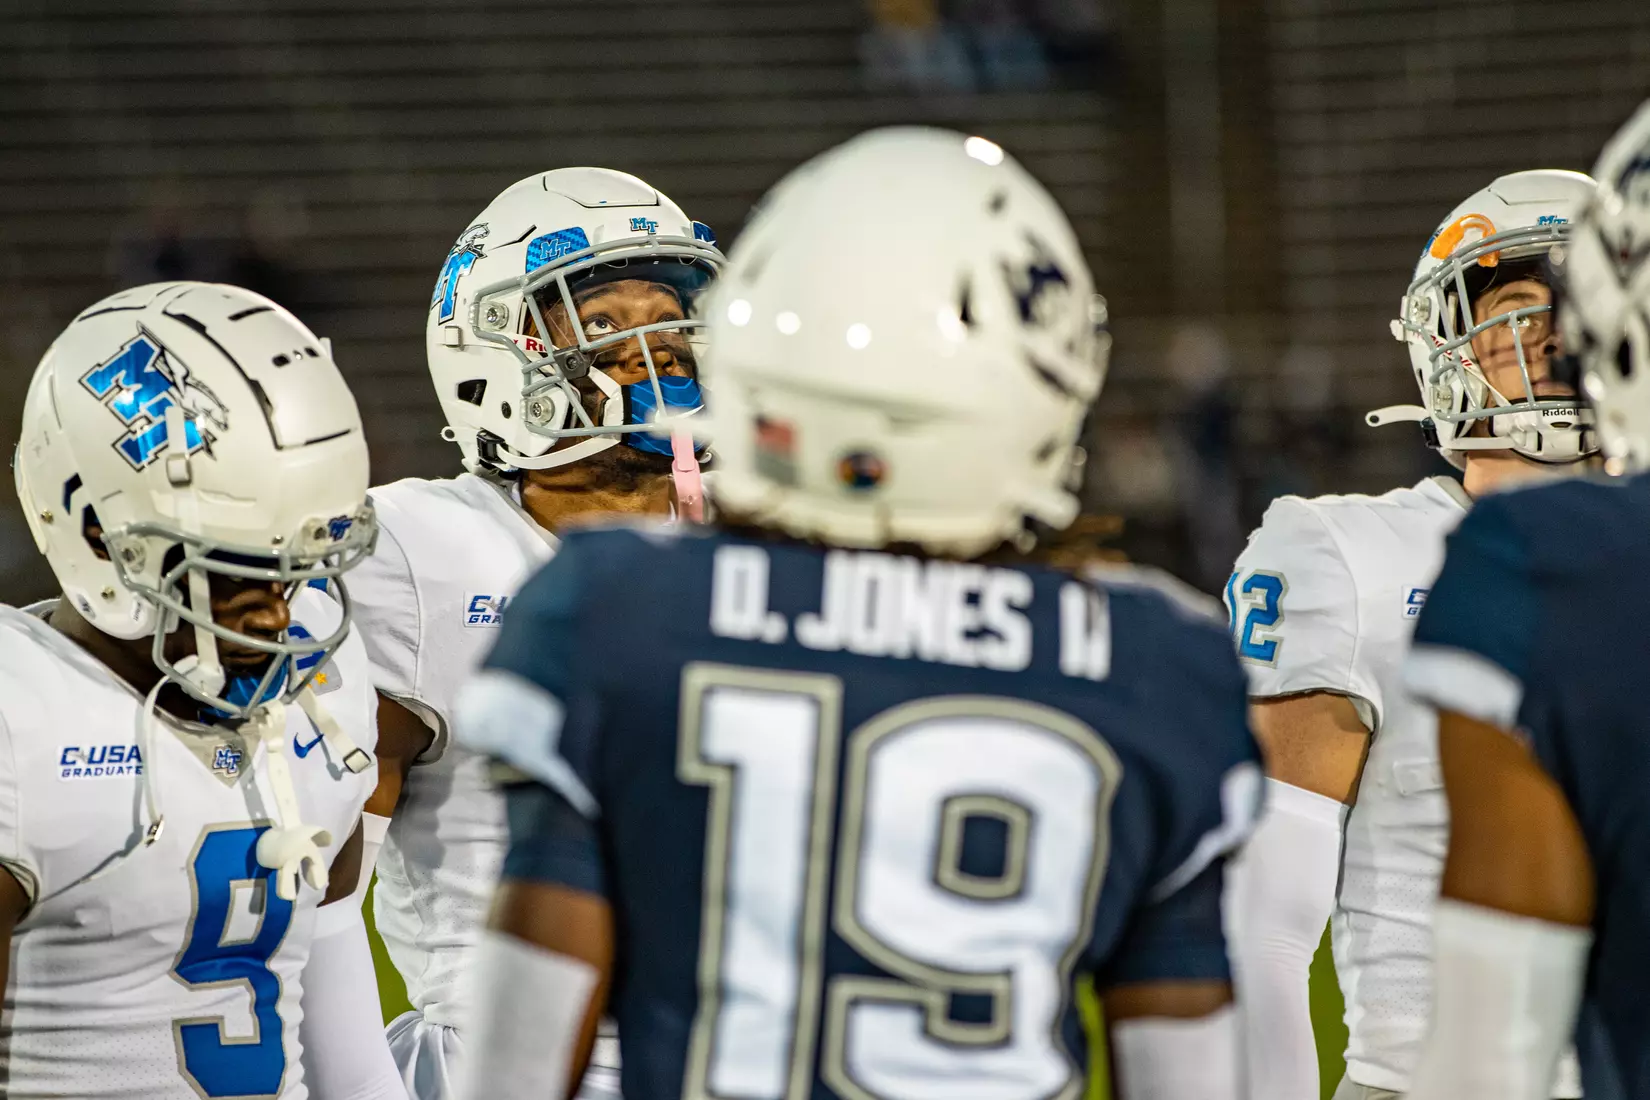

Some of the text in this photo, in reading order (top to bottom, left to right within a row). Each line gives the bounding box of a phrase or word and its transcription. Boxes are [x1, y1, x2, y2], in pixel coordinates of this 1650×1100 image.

[794, 549, 1035, 672] JONES
[60, 765, 144, 778] GRADUATE
[167, 817, 300, 1100] 9
[676, 660, 1123, 1100] 19
